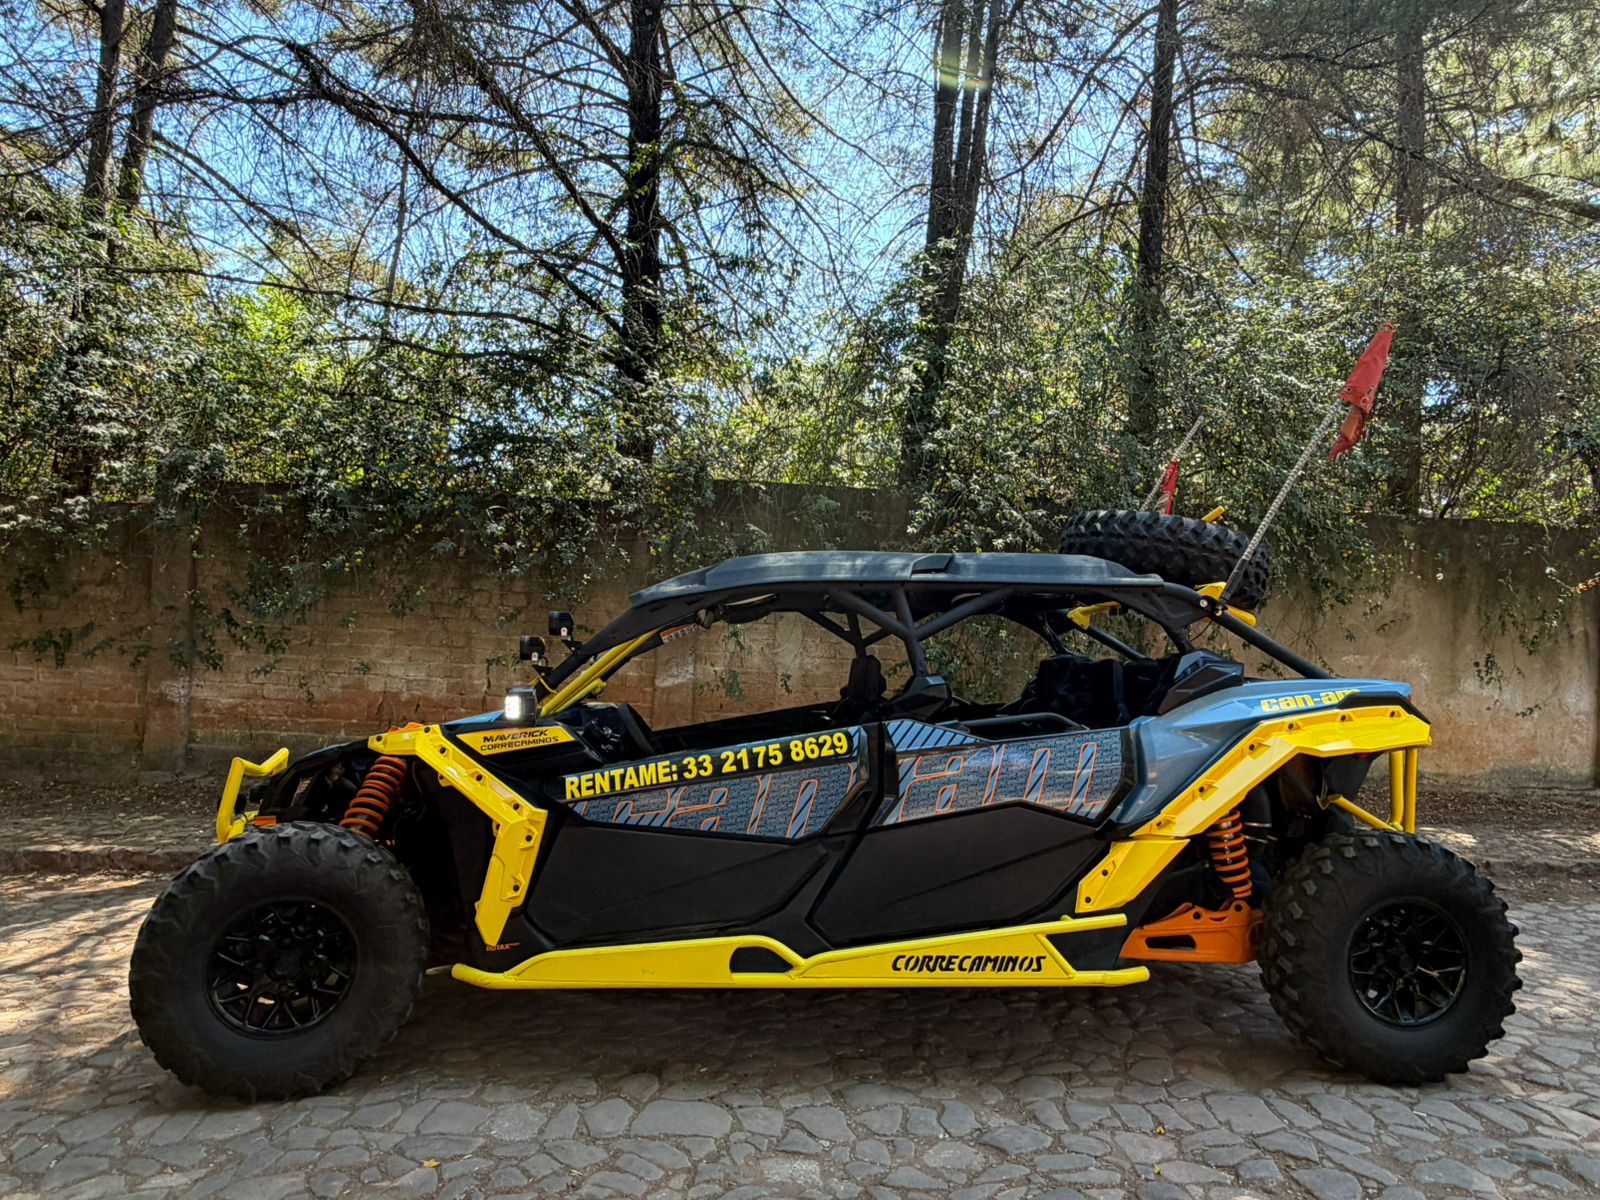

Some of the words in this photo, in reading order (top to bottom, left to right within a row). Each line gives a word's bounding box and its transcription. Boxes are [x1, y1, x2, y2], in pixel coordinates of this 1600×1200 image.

[480, 736, 559, 751] CORRECAMINOS
[483, 729, 549, 743] MAVERICK
[565, 760, 678, 800] RENTAME:
[683, 756, 713, 779] 33
[720, 741, 783, 773] 2175
[790, 732, 848, 762] 8629
[891, 954, 1047, 973] CORRECAMINOS
